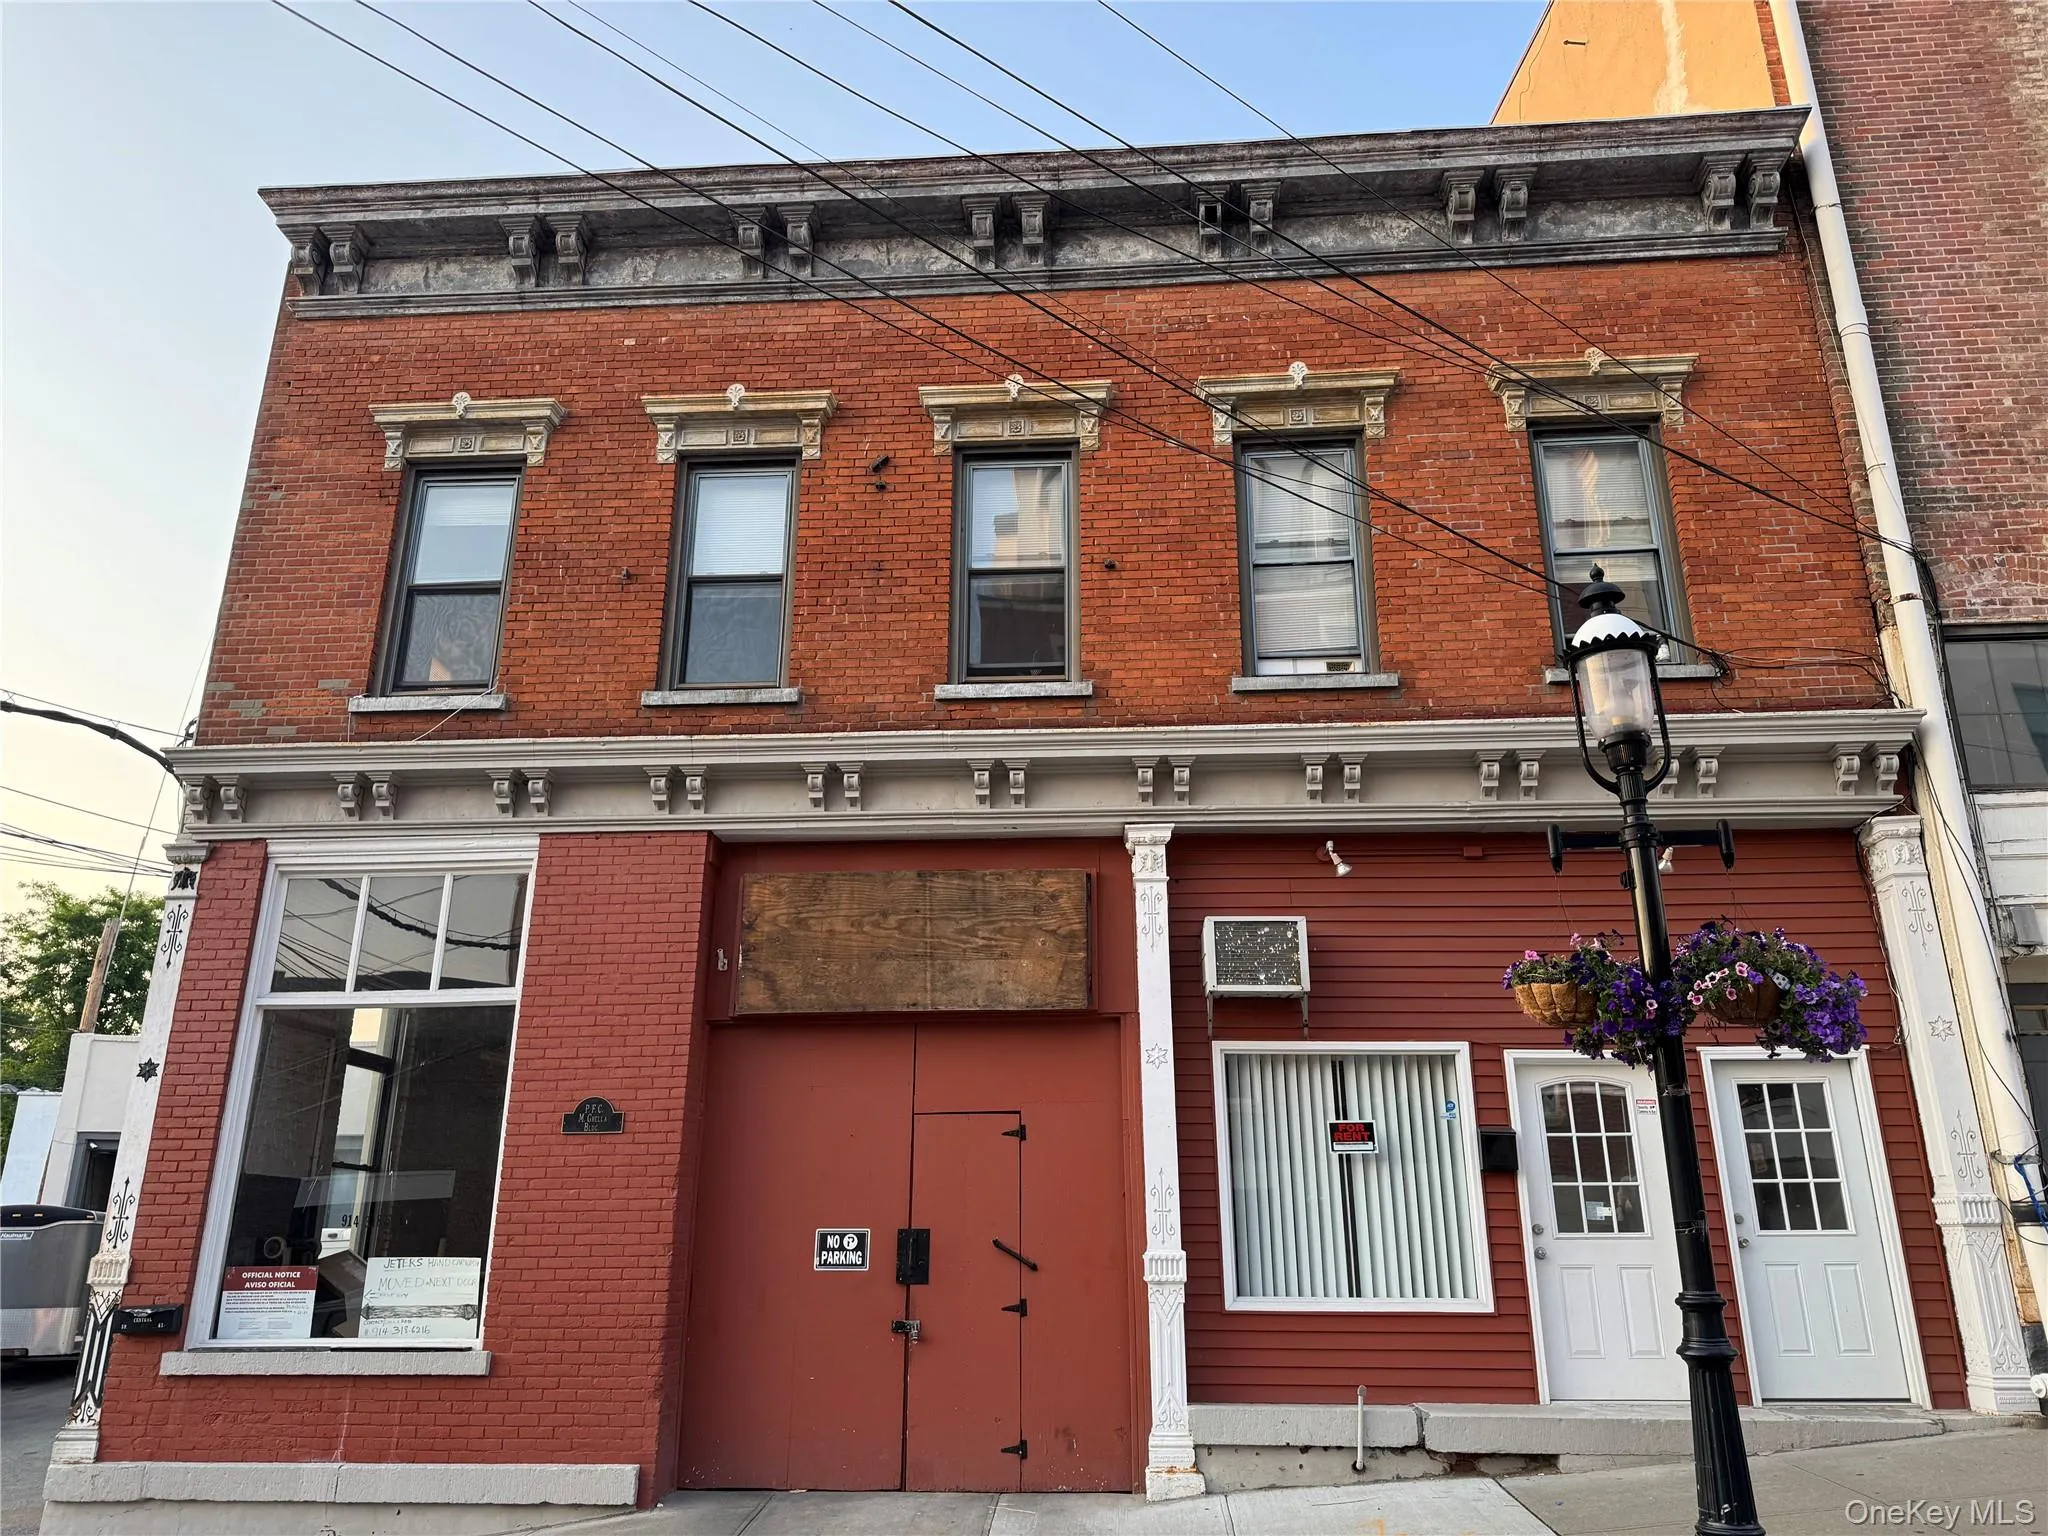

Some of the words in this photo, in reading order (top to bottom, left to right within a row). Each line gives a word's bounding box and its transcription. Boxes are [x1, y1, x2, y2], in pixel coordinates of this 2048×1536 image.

[1338, 1124, 1365, 1132] FOR
[1334, 1132, 1370, 1142] RENT
[341, 1214, 359, 1228] 914
[827, 1234, 840, 1249] NO
[821, 1250, 863, 1265] PARKING
[383, 1258, 424, 1269] JETERS
[241, 1271, 274, 1279] OFFICIAL
[274, 1271, 301, 1279] NOTICE
[244, 1281, 267, 1289] AVISO
[378, 1277, 425, 1291] MOVED
